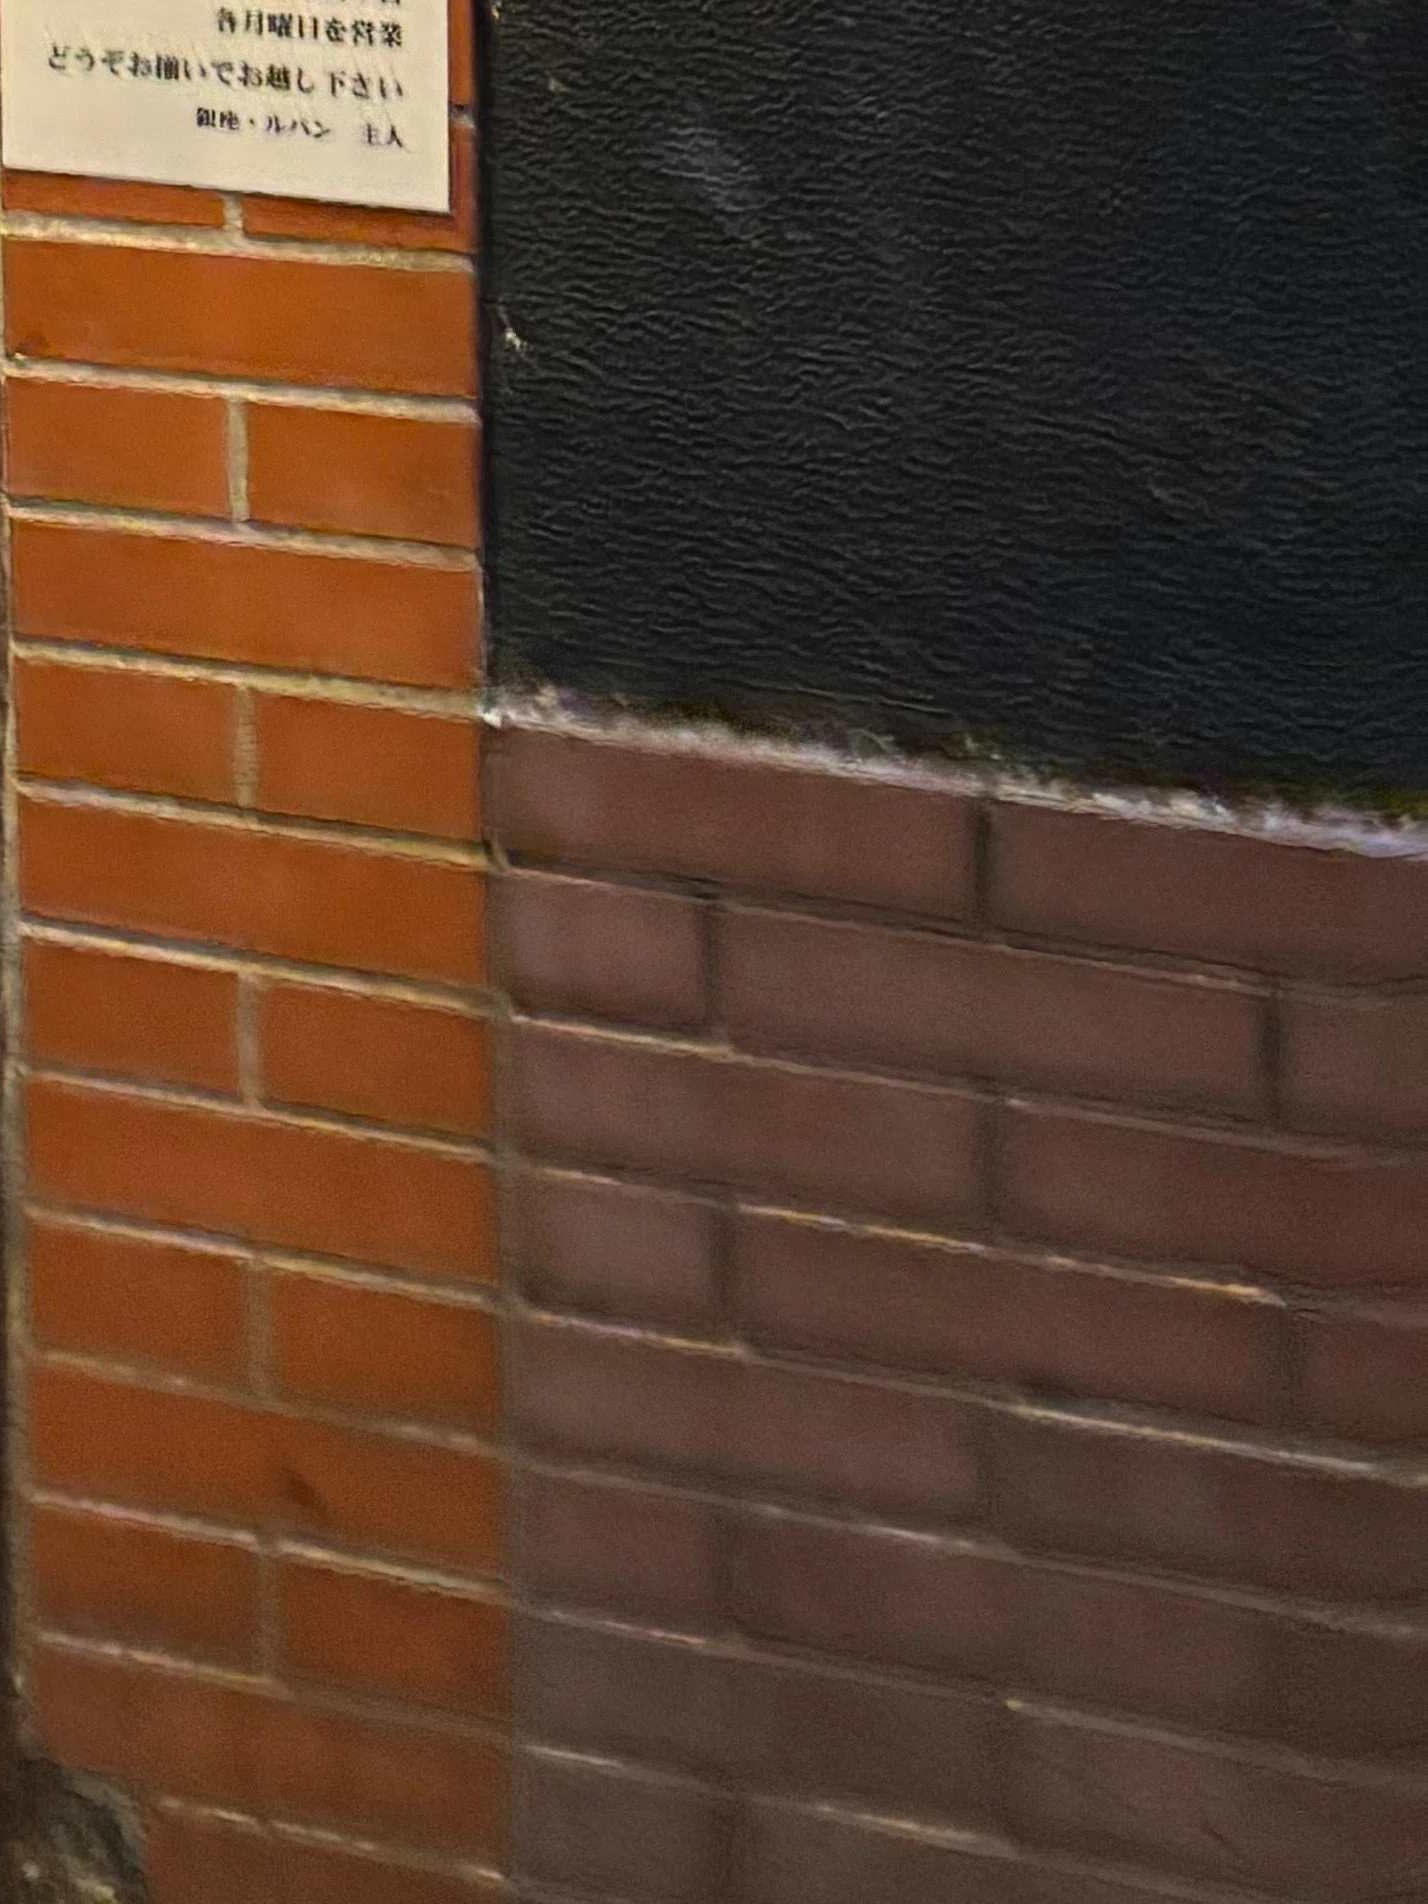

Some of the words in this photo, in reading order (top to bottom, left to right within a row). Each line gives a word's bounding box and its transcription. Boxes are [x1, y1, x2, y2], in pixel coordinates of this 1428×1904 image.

[215, 6, 403, 49] 各月曜日を営業
[48, 46, 404, 99] どうぞお揃いでお越し下さい
